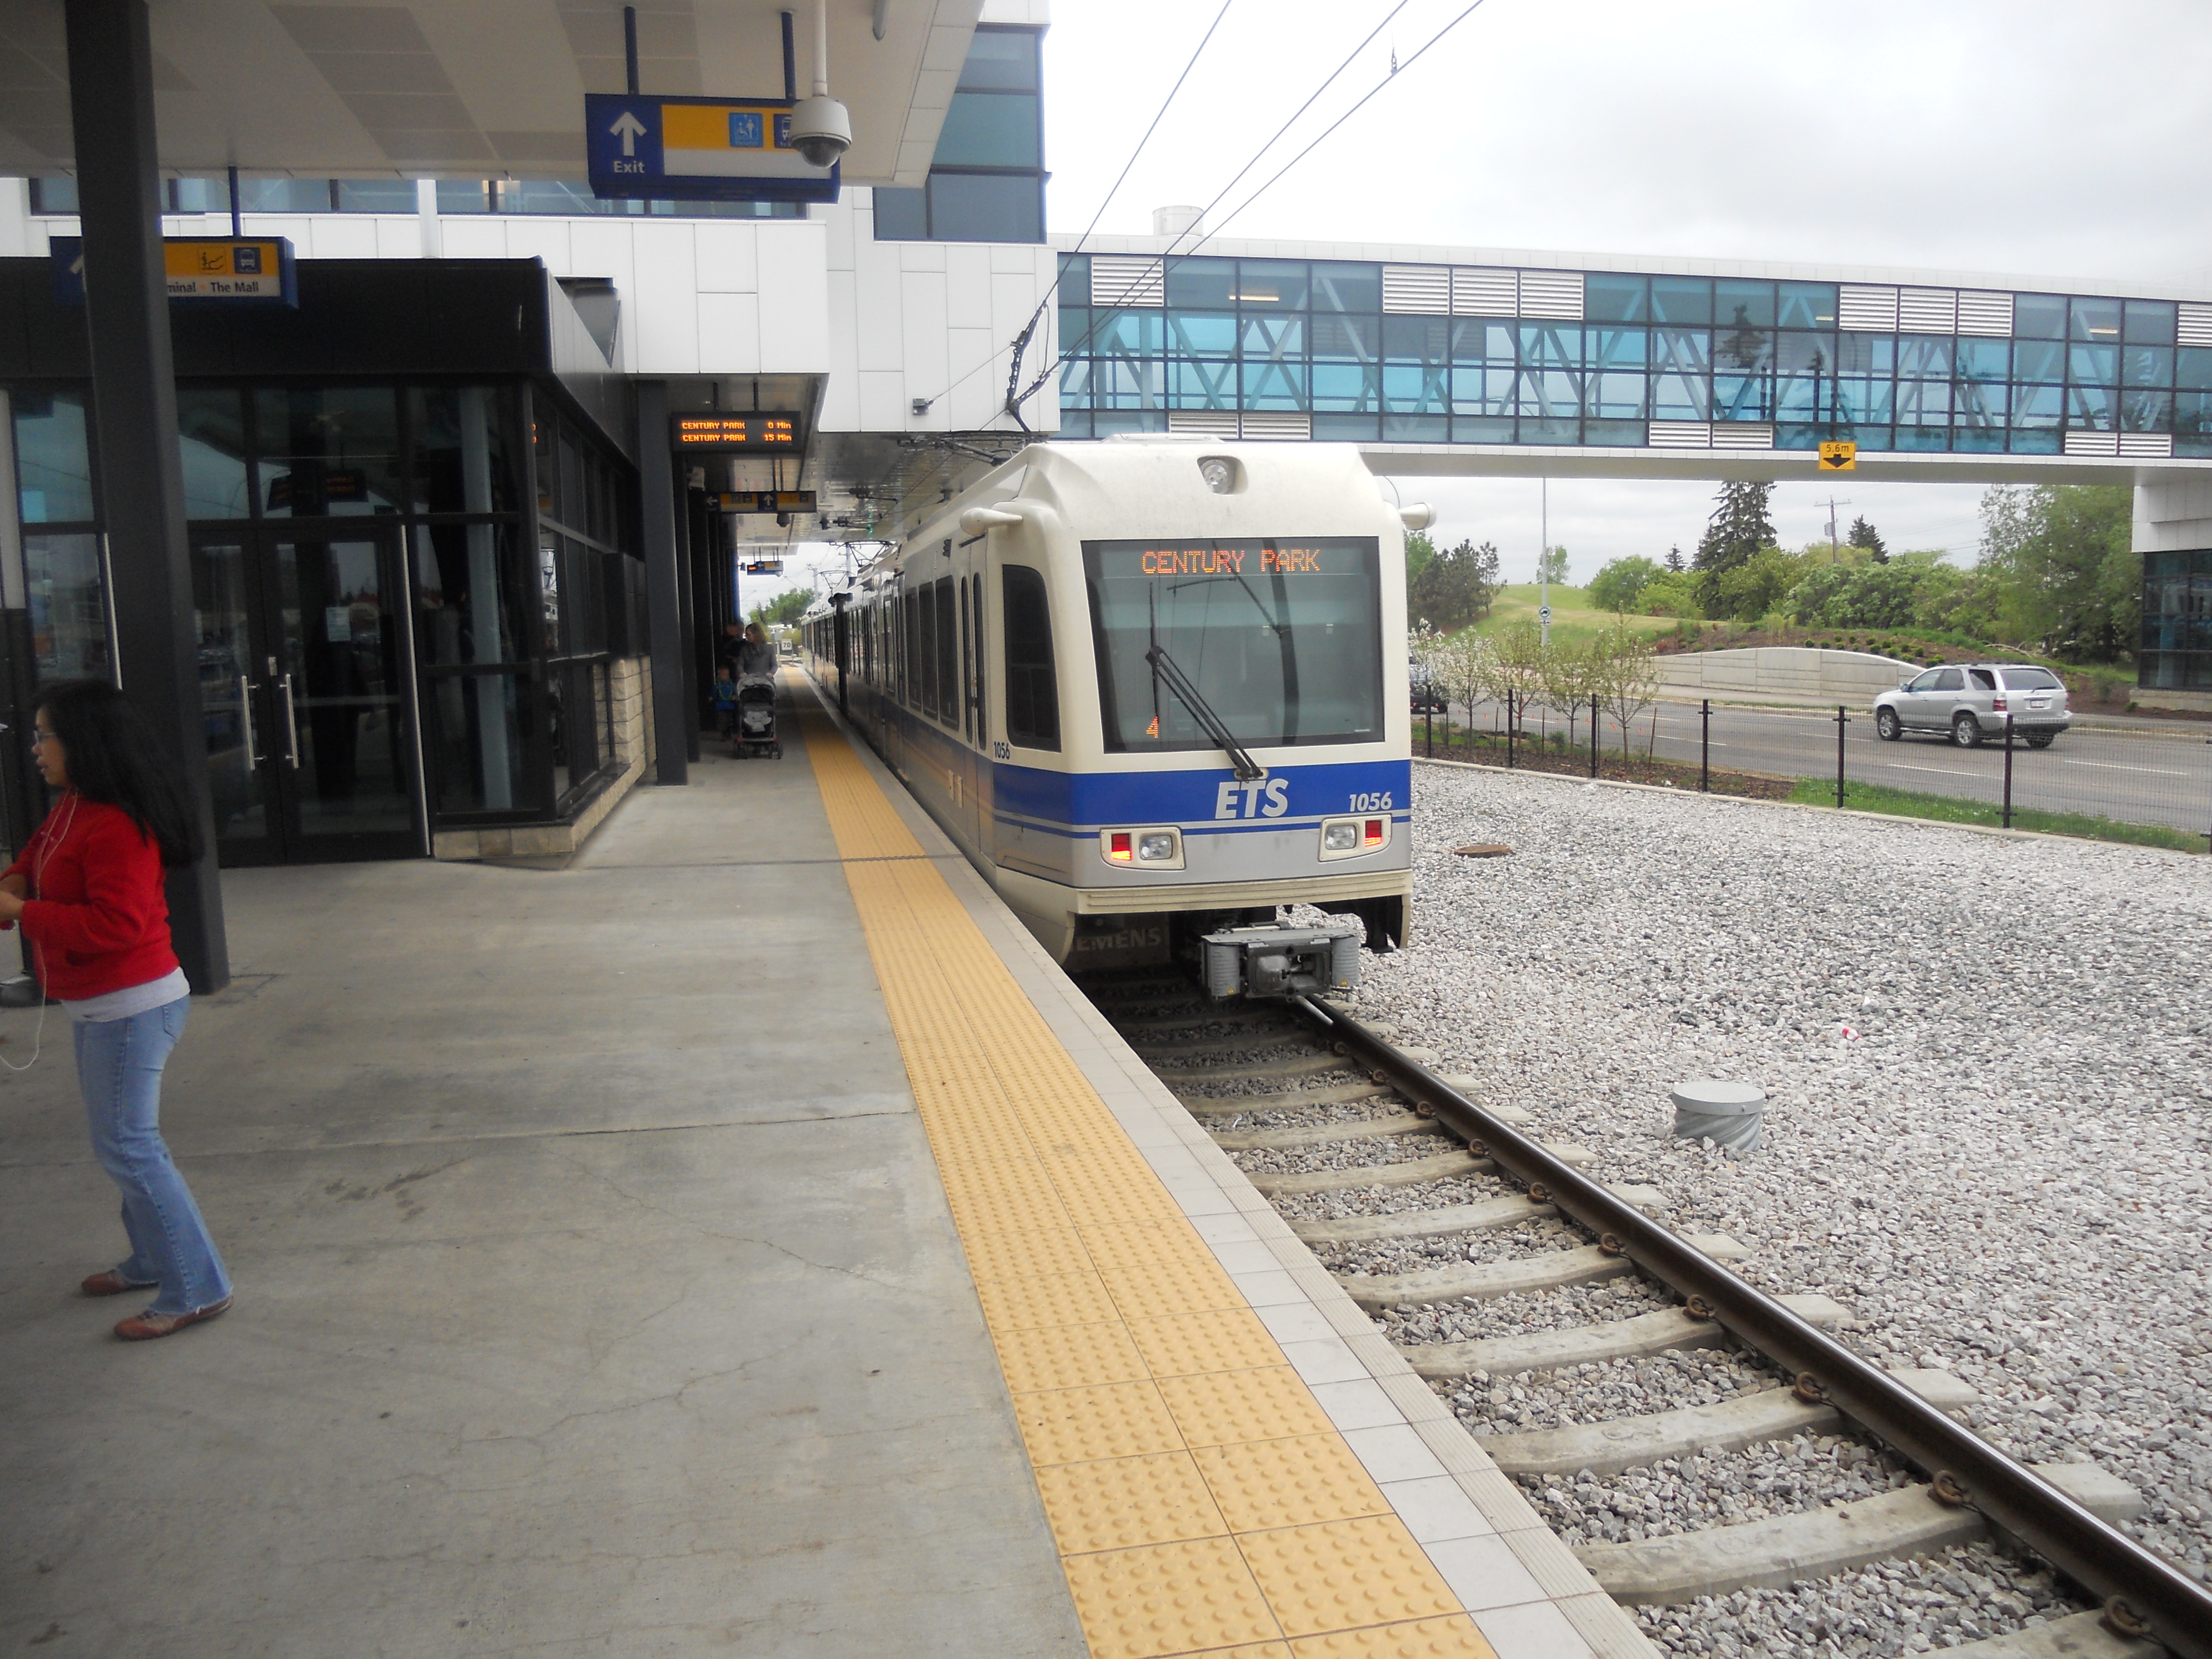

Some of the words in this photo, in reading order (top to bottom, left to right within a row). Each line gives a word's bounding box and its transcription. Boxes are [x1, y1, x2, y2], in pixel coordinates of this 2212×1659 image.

[613, 160, 645, 173] Exit
[168, 282, 196, 293] minal
[211, 282, 231, 293] The
[234, 281, 259, 293] Mall
[682, 421, 720, 430] CENTURY
[682, 434, 721, 442] CENTURY
[1826, 444, 1849, 452] 5.6m
[1142, 550, 1245, 574] CENTURY
[1261, 549, 1321, 572] PARK
[1146, 716, 1159, 738] 4
[994, 740, 1011, 760] 1056
[1214, 778, 1290, 820] ETS
[1349, 791, 1392, 812] 1056
[1070, 927, 1162, 952] EMENS
